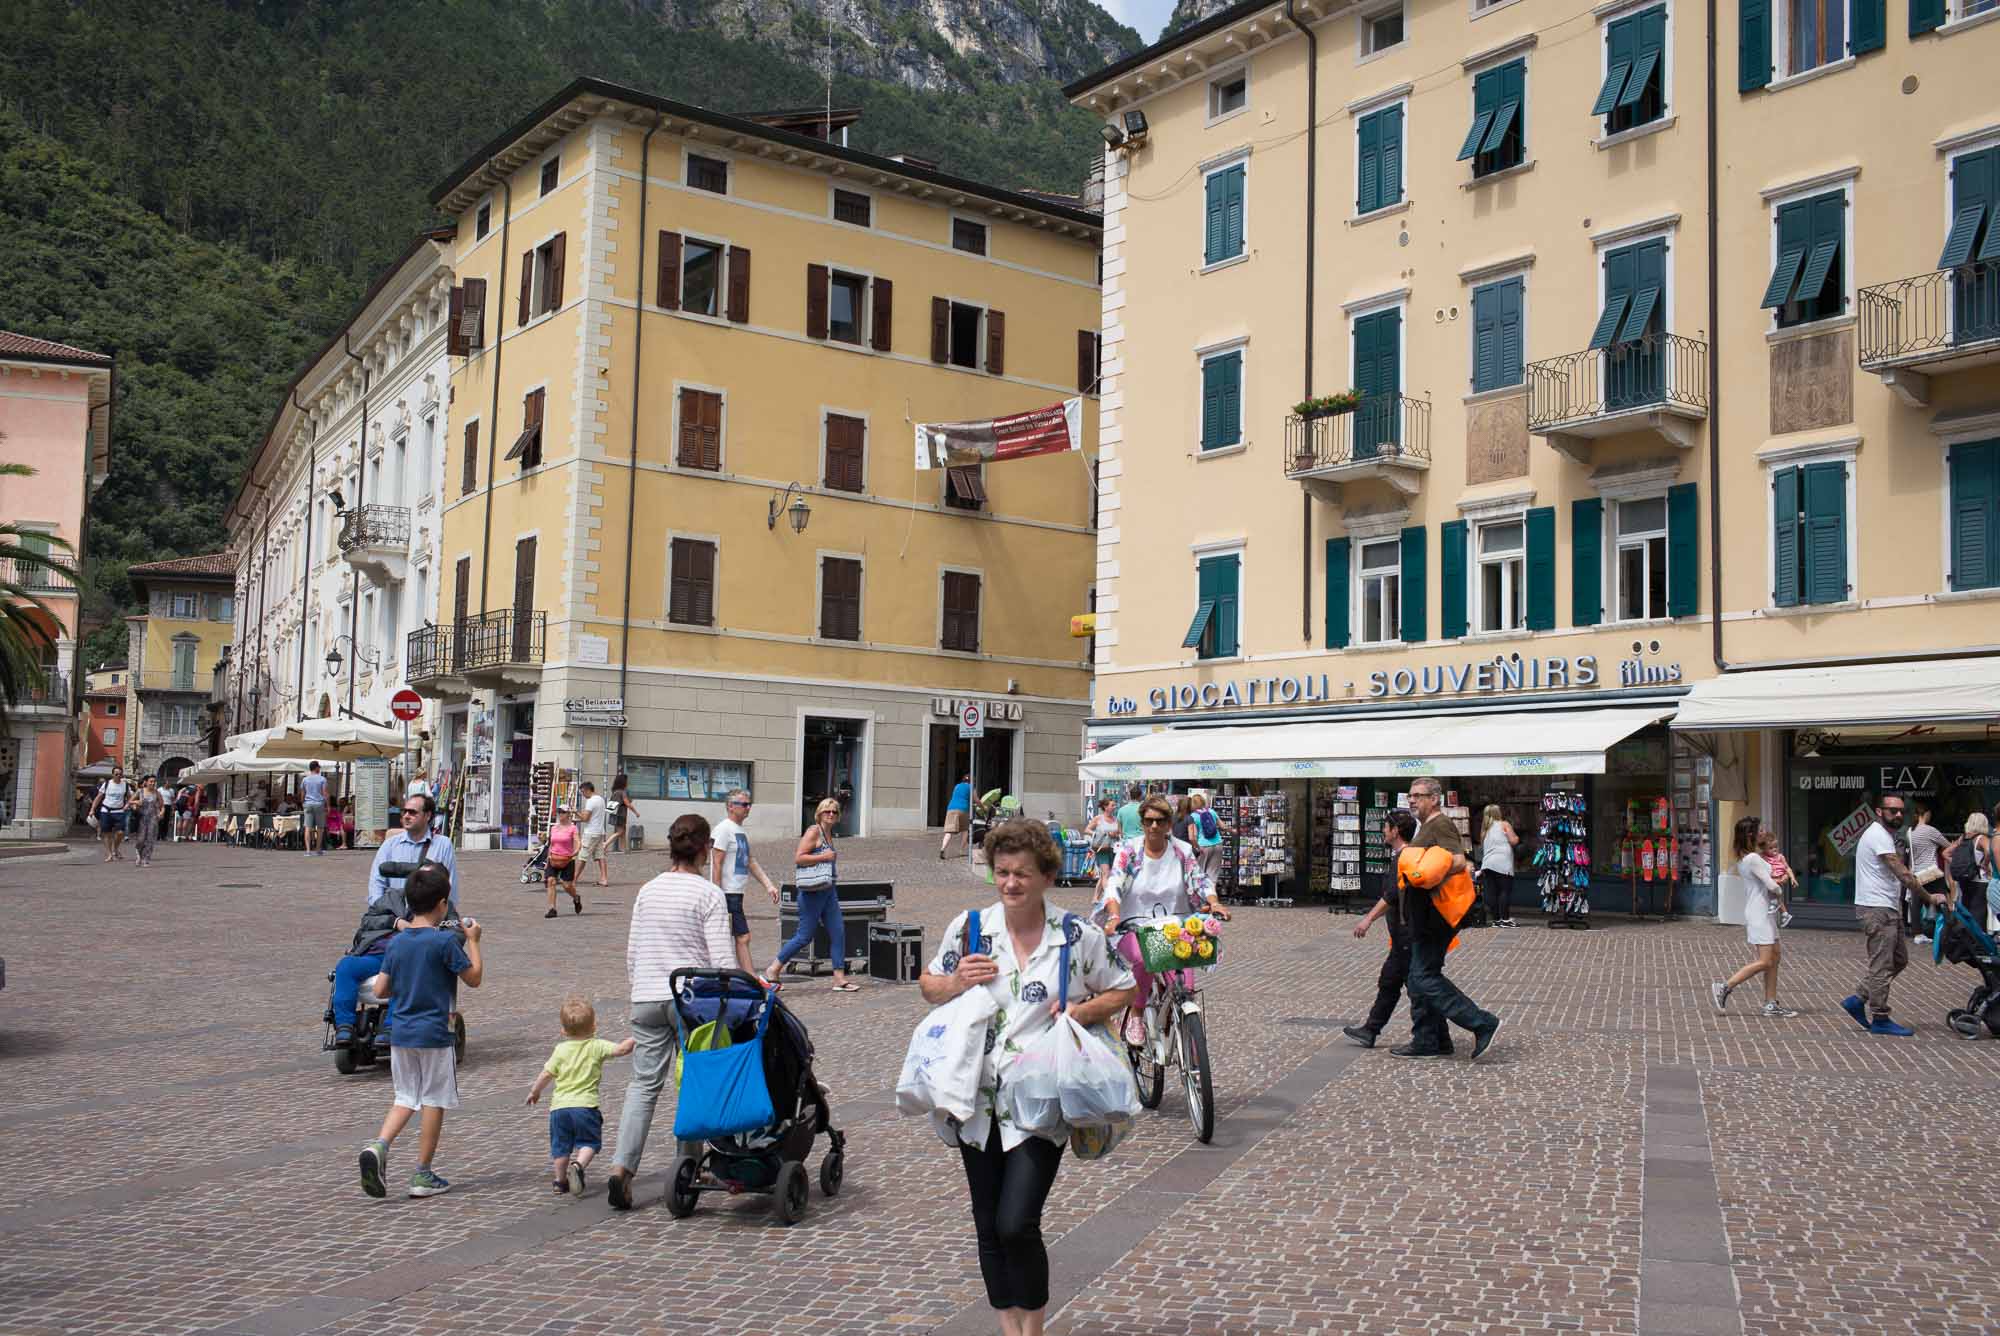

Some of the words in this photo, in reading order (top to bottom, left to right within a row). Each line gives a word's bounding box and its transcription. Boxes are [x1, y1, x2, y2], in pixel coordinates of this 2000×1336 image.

[1108, 695, 1137, 714] foto
[1149, 673, 1329, 711] GIOCATTOLI
[1368, 654, 1598, 697] SOUVENIRS
[1618, 656, 1683, 686] films
[934, 696, 1022, 720] LRA
[1814, 776, 1838, 790] CAMP
[1840, 776, 1865, 790] DAVID
[1880, 766, 1935, 789] EA7
[1955, 775, 1984, 787] Calvin
[1833, 807, 1872, 847] SALDI
